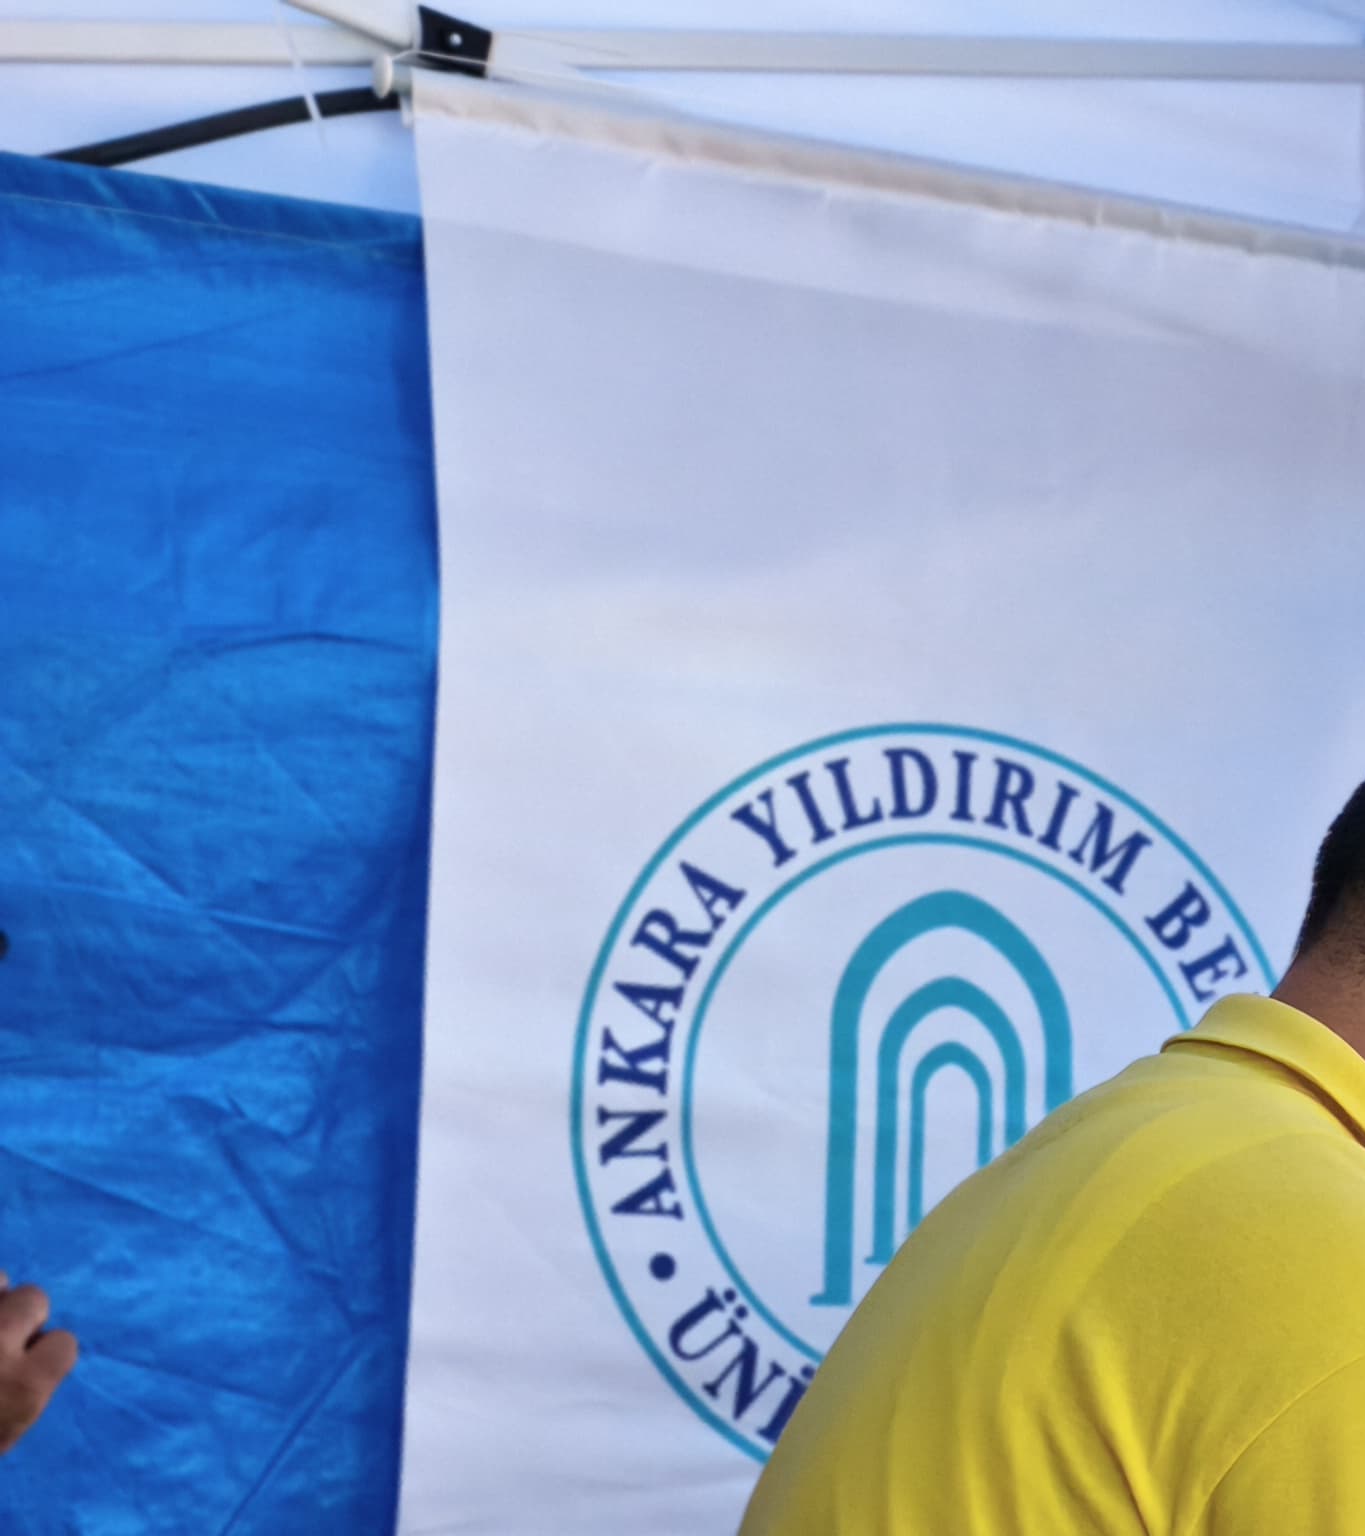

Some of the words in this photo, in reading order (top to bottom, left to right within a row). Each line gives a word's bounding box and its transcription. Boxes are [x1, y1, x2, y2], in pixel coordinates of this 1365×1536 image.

[597, 861, 746, 1221] ANKARA
[731, 747, 1151, 895] YILDIRIM
[1144, 880, 1259, 1002] BE
